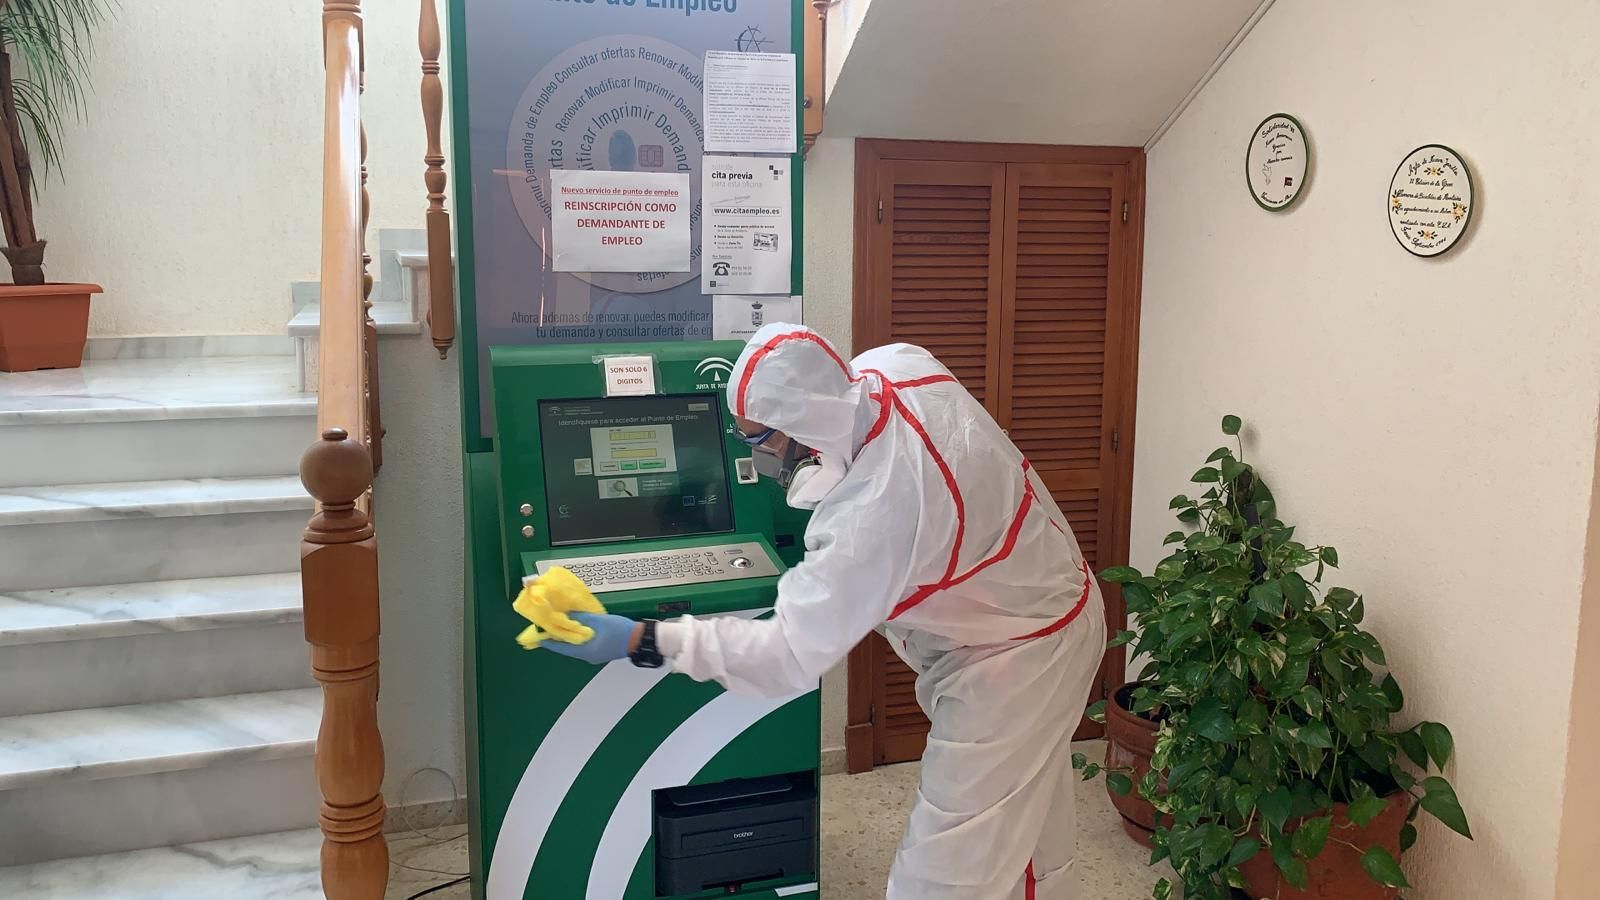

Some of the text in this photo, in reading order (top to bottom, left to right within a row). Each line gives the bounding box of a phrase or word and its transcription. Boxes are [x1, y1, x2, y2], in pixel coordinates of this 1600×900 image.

[600, 46, 636, 61] ofertas
[638, 46, 680, 70] Renovar
[555, 52, 599, 84] Consultar
[529, 81, 558, 116] Empleo
[555, 96, 587, 132] Renovar
[584, 77, 631, 101] Modificar
[634, 76, 675, 102] Imprimir
[592, 101, 654, 130] Imprimir
[525, 116, 538, 130] de
[521, 132, 537, 184] Demanda
[711, 170, 753, 181] cita previa
[561, 186, 584, 194] Nuevo
[622, 188, 643, 197] punto
[654, 188, 679, 197] empleo
[564, 200, 677, 213] REINSCRIPCIÓN COMO
[713, 207, 780, 216] www.citaempleo.es
[577, 218, 666, 229] DEMANDANTE DE
[601, 236, 643, 246] EMPLEO
[511, 311, 541, 324] Ahora
[543, 311, 580, 323] además
[582, 311, 593, 323] de
[634, 310, 666, 324] puedes
[668, 310, 710, 321] modificar
[536, 327, 546, 338] tu
[549, 326, 596, 338] demanda
[598, 328, 605, 339] y
[606, 325, 650, 338] consultar
[653, 323, 685, 336] ofertas
[688, 324, 699, 336] de
[610, 366, 624, 374] SON
[625, 366, 642, 374] SOLO
[733, 831, 754, 839] brother
